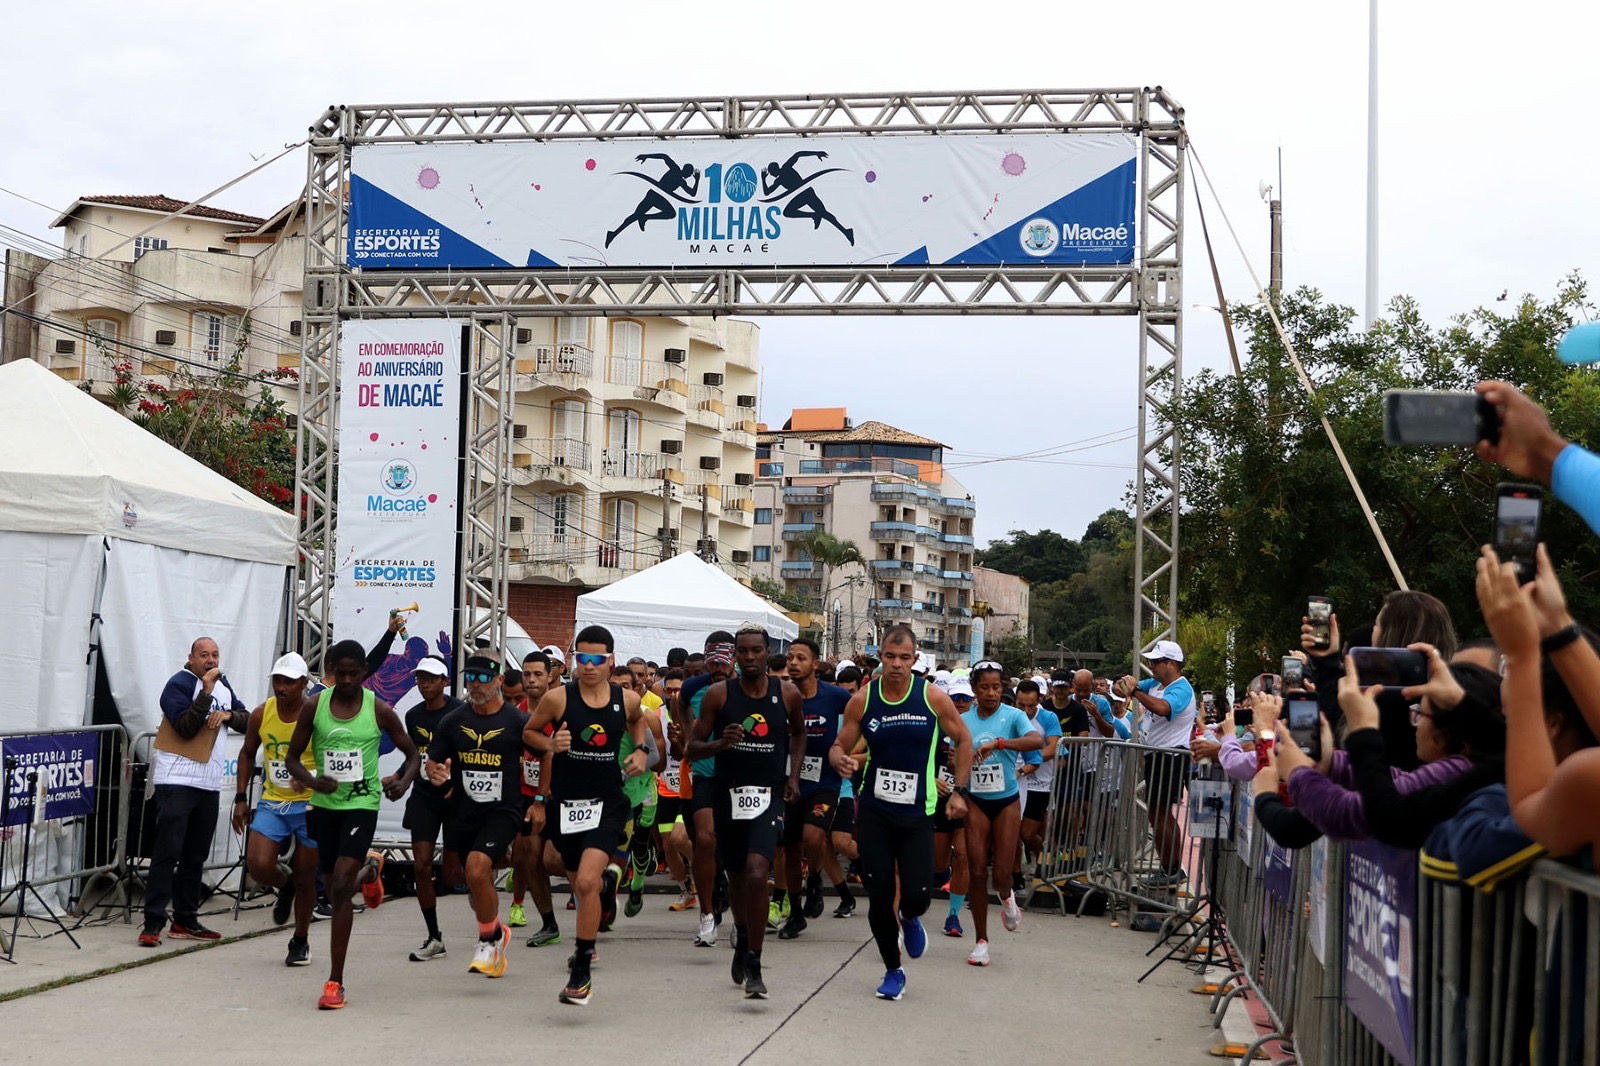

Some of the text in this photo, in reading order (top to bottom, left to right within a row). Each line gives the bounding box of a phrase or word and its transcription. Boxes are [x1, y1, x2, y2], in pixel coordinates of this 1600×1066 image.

[704, 162, 758, 204] 10
[677, 205, 782, 241] MILHAS
[1062, 222, 1129, 241] Macaé
[354, 236, 441, 251] ESPORTES
[689, 241, 770, 254] MACAÉ
[358, 340, 444, 358] EM COMEMORAÇÃO
[358, 358, 444, 376] AO ANIVERSÁRIO
[358, 378, 444, 407] DE MACAÉ
[367, 495, 427, 512] Macaé
[354, 566, 436, 582] ESPORTES
[882, 713, 928, 722] Santiliano
[71, 749, 82, 760] DE
[458, 752, 502, 766] PEGASUS
[329, 760, 352, 771] 384
[275, 770, 290, 779] 68
[528, 770, 540, 778] 59
[944, 774, 956, 784] 73
[976, 773, 994, 783] 171
[469, 780, 492, 792] 692
[670, 777, 680, 786] 83
[882, 780, 907, 793] 513
[54, 792, 66, 802] COM
[738, 796, 760, 808] 808
[568, 808, 592, 822] 802
